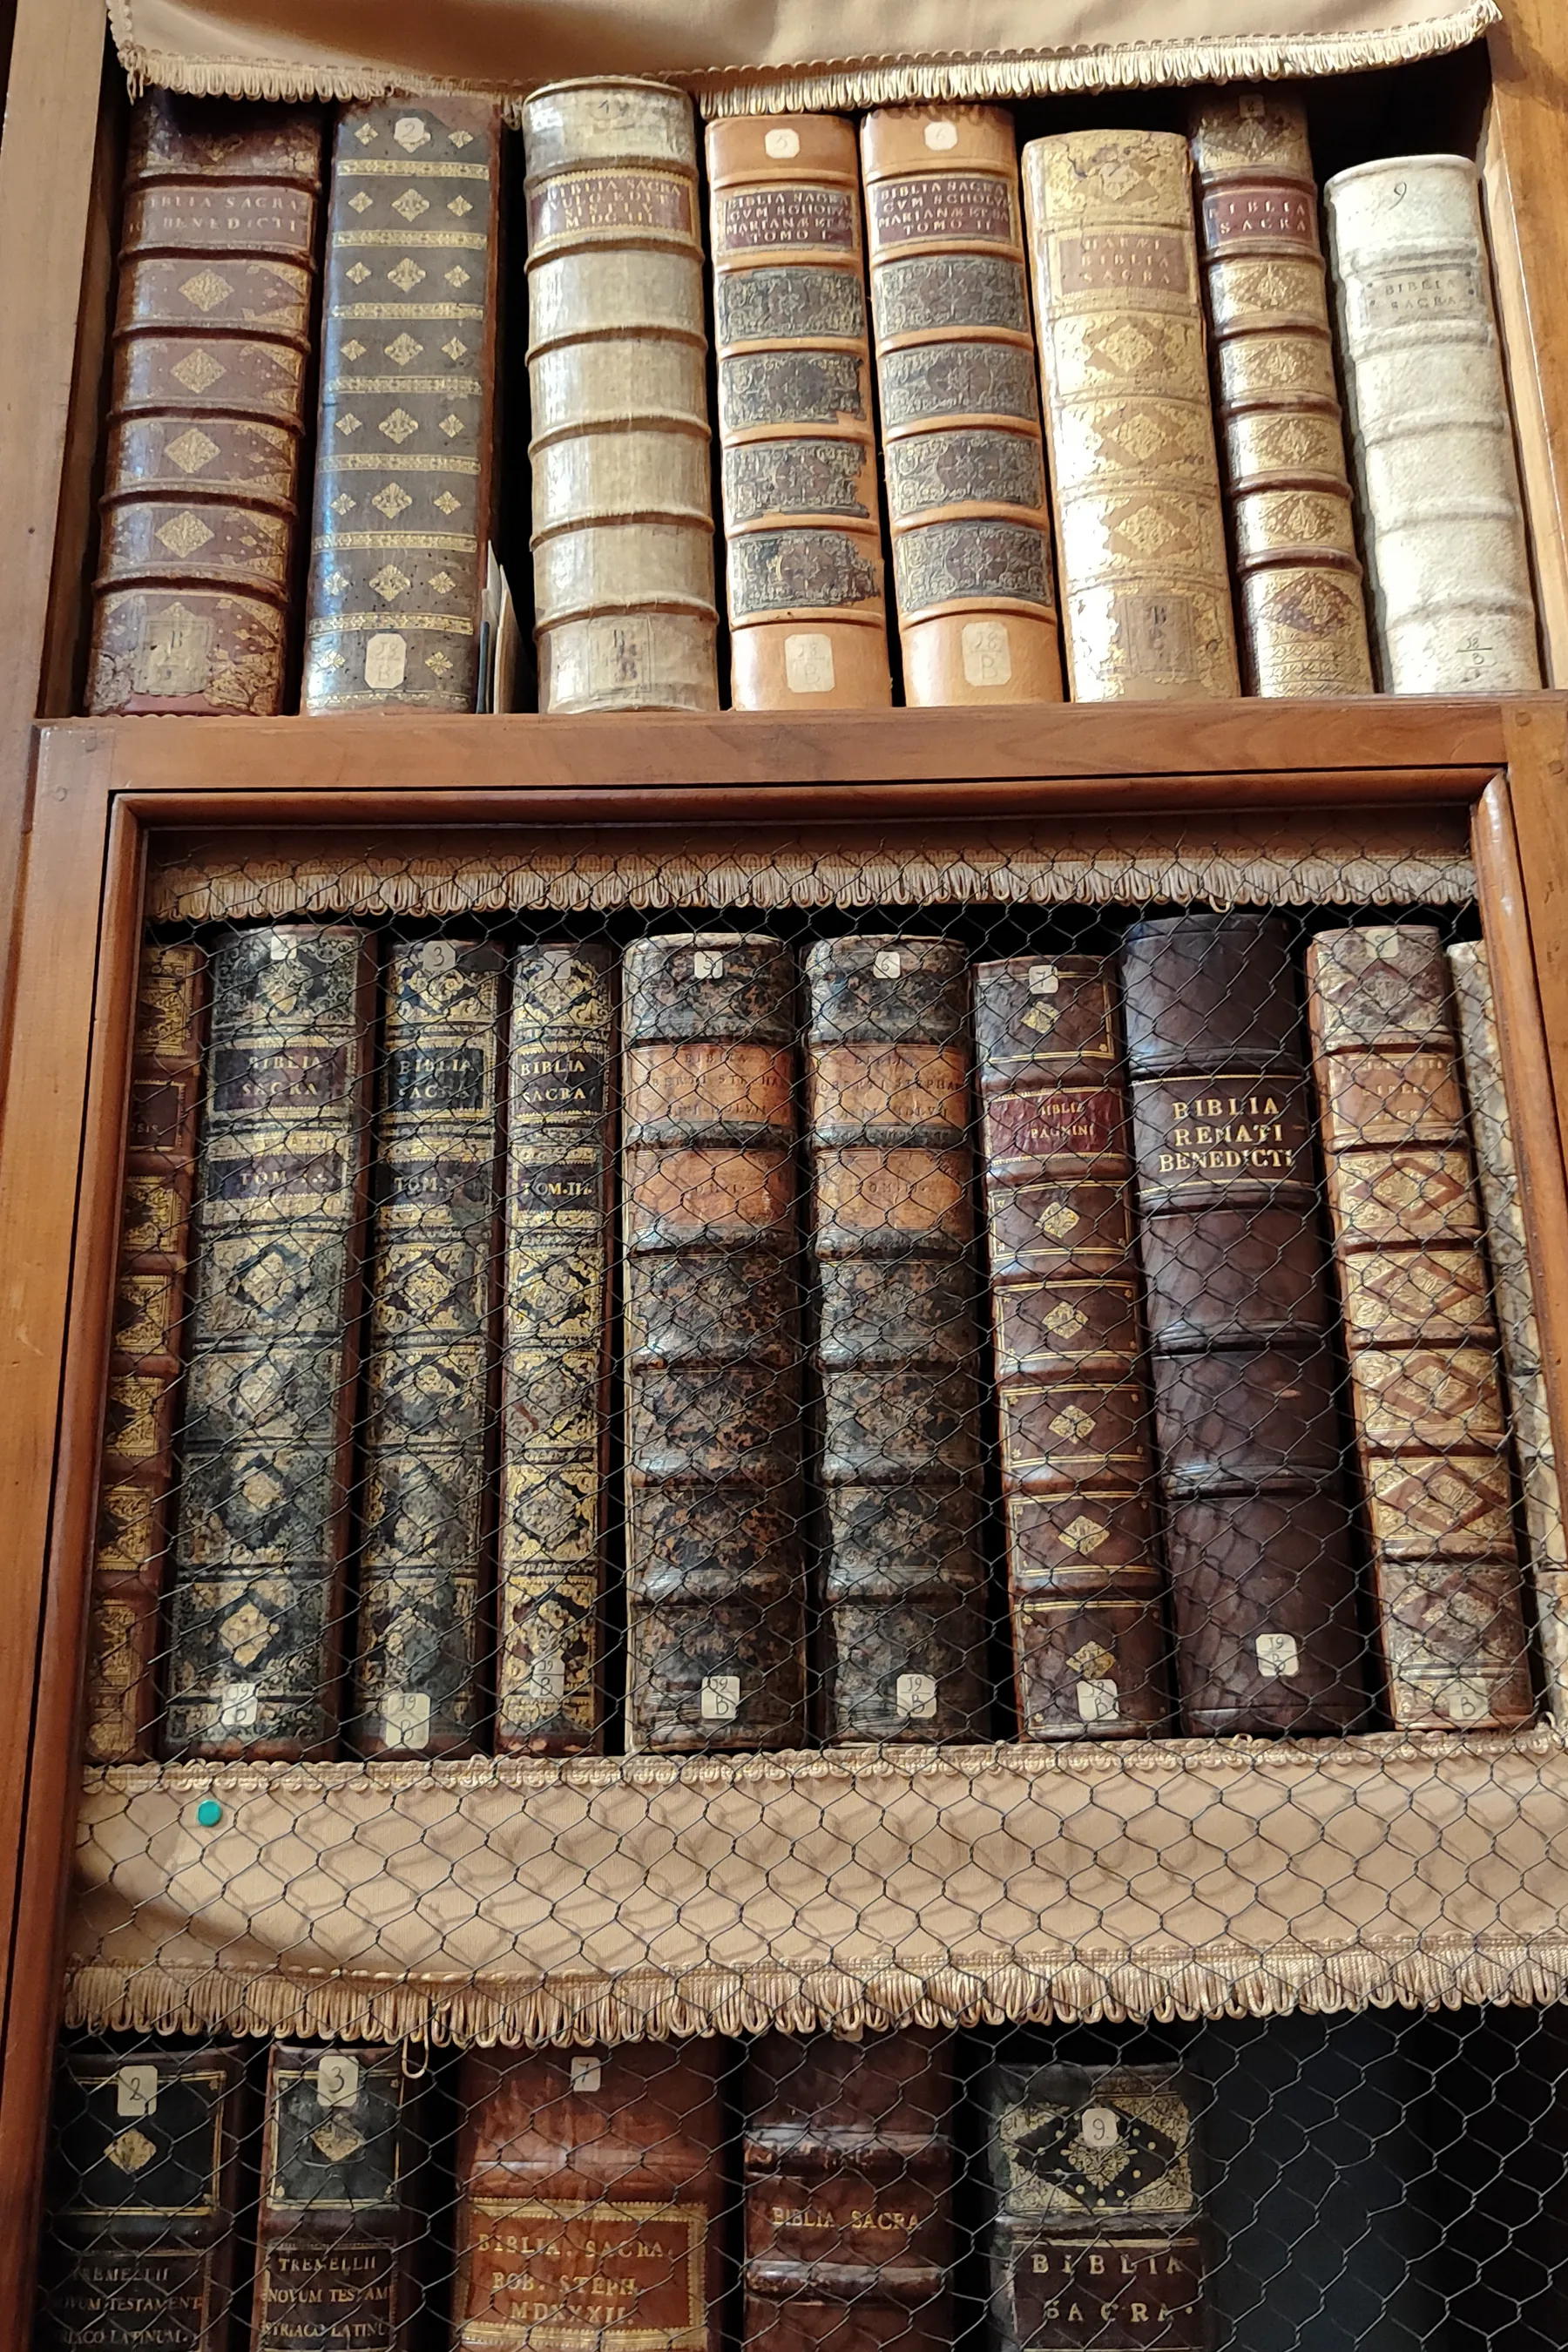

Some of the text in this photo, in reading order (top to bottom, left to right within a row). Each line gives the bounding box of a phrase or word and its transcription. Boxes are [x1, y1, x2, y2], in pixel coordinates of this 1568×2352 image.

[402, 123, 415, 138] 2
[881, 182, 941, 200] BIBLIA
[1387, 181, 1407, 211] 9
[138, 197, 297, 211] IBLIA SACRA
[903, 220, 963, 236] TOMO
[1220, 218, 1306, 234] SACRA
[750, 230, 809, 244] TOMO
[1082, 253, 1169, 267] BIBLIA
[1084, 268, 1171, 285] SACRA
[1386, 279, 1455, 296] BIBLIA
[981, 655, 999, 680] B
[434, 946, 444, 967] 3
[881, 956, 889, 971] 6
[1036, 970, 1045, 988] 7
[248, 1057, 325, 1070] BIBLIA
[398, 1059, 475, 1075] BIBLIA
[521, 1059, 585, 1077] BIBLIA
[242, 1081, 318, 1096] SACRA
[523, 1087, 586, 1103] SACRA
[1172, 1097, 1279, 1120] BIBLIA
[1031, 1124, 1094, 1139] PAGNINI
[1174, 1124, 1282, 1147] RENATI
[1159, 1149, 1293, 1173] BENEDICTI
[715, 1695, 729, 1715] B
[1461, 1697, 1476, 1716] B
[328, 2066, 345, 2094] 3
[578, 2062, 591, 2084] 7
[130, 2077, 141, 2101] 2
[772, 2207, 835, 2228] BIBLIA
[1031, 2254, 1183, 2275] BIBLIA
[328, 2287, 390, 2302] TESAM
